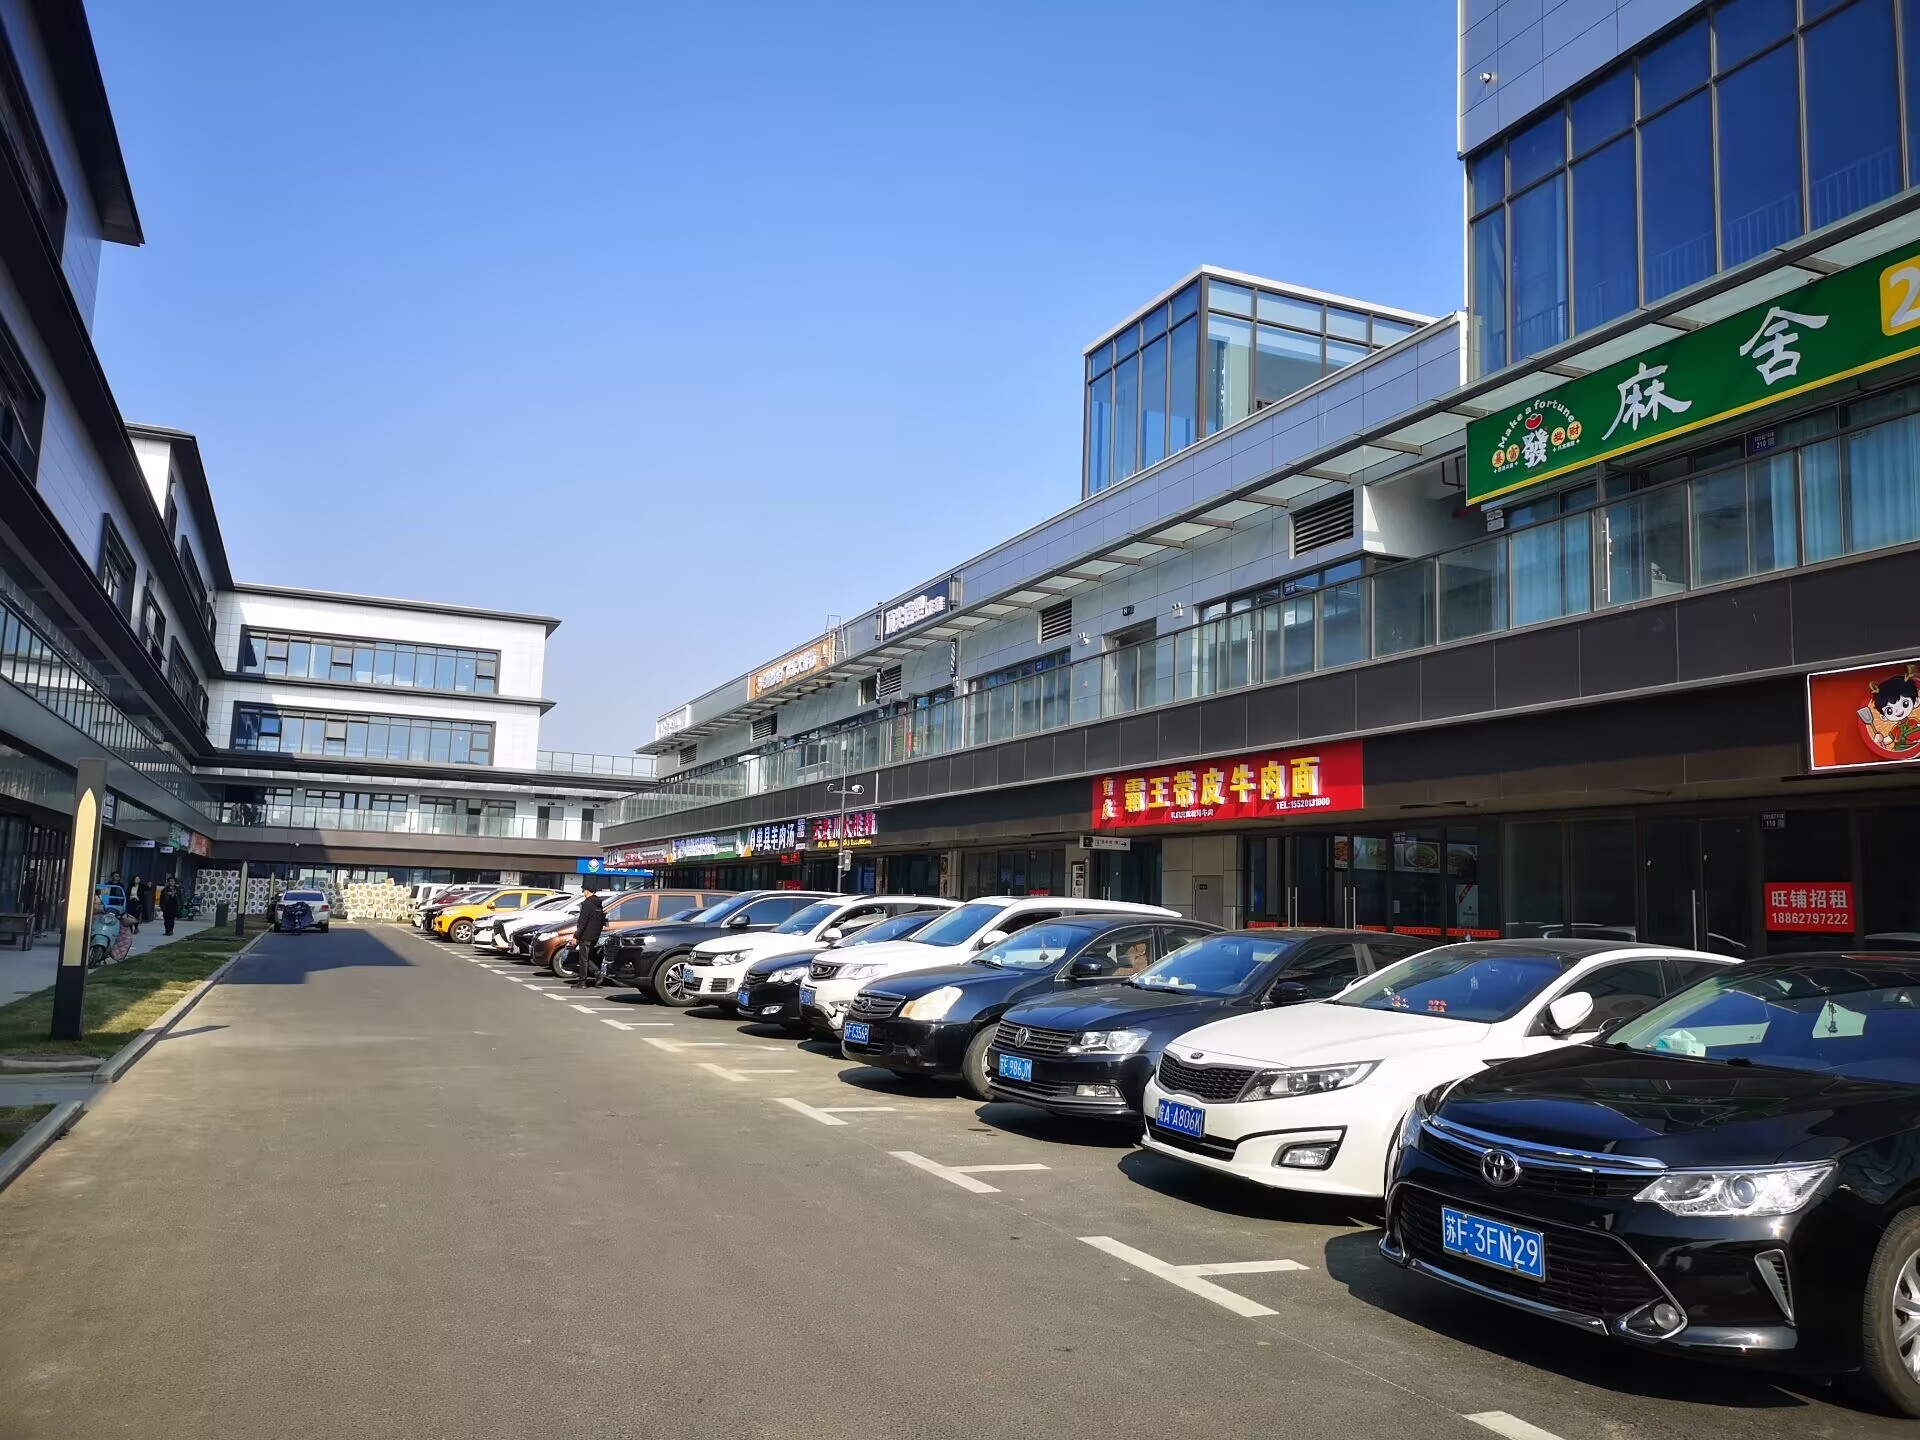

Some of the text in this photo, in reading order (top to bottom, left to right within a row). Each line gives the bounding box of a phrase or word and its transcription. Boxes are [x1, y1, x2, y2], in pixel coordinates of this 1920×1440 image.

[1497, 399, 1575, 448] Make a fortune
[1124, 756, 1321, 812] 霸王带皮牛肉面
[1771, 889, 1848, 909] 旺铺招租
[1771, 912, 1849, 925] 18862797222
[1446, 1214, 1538, 1268] 苏F·3FN29
